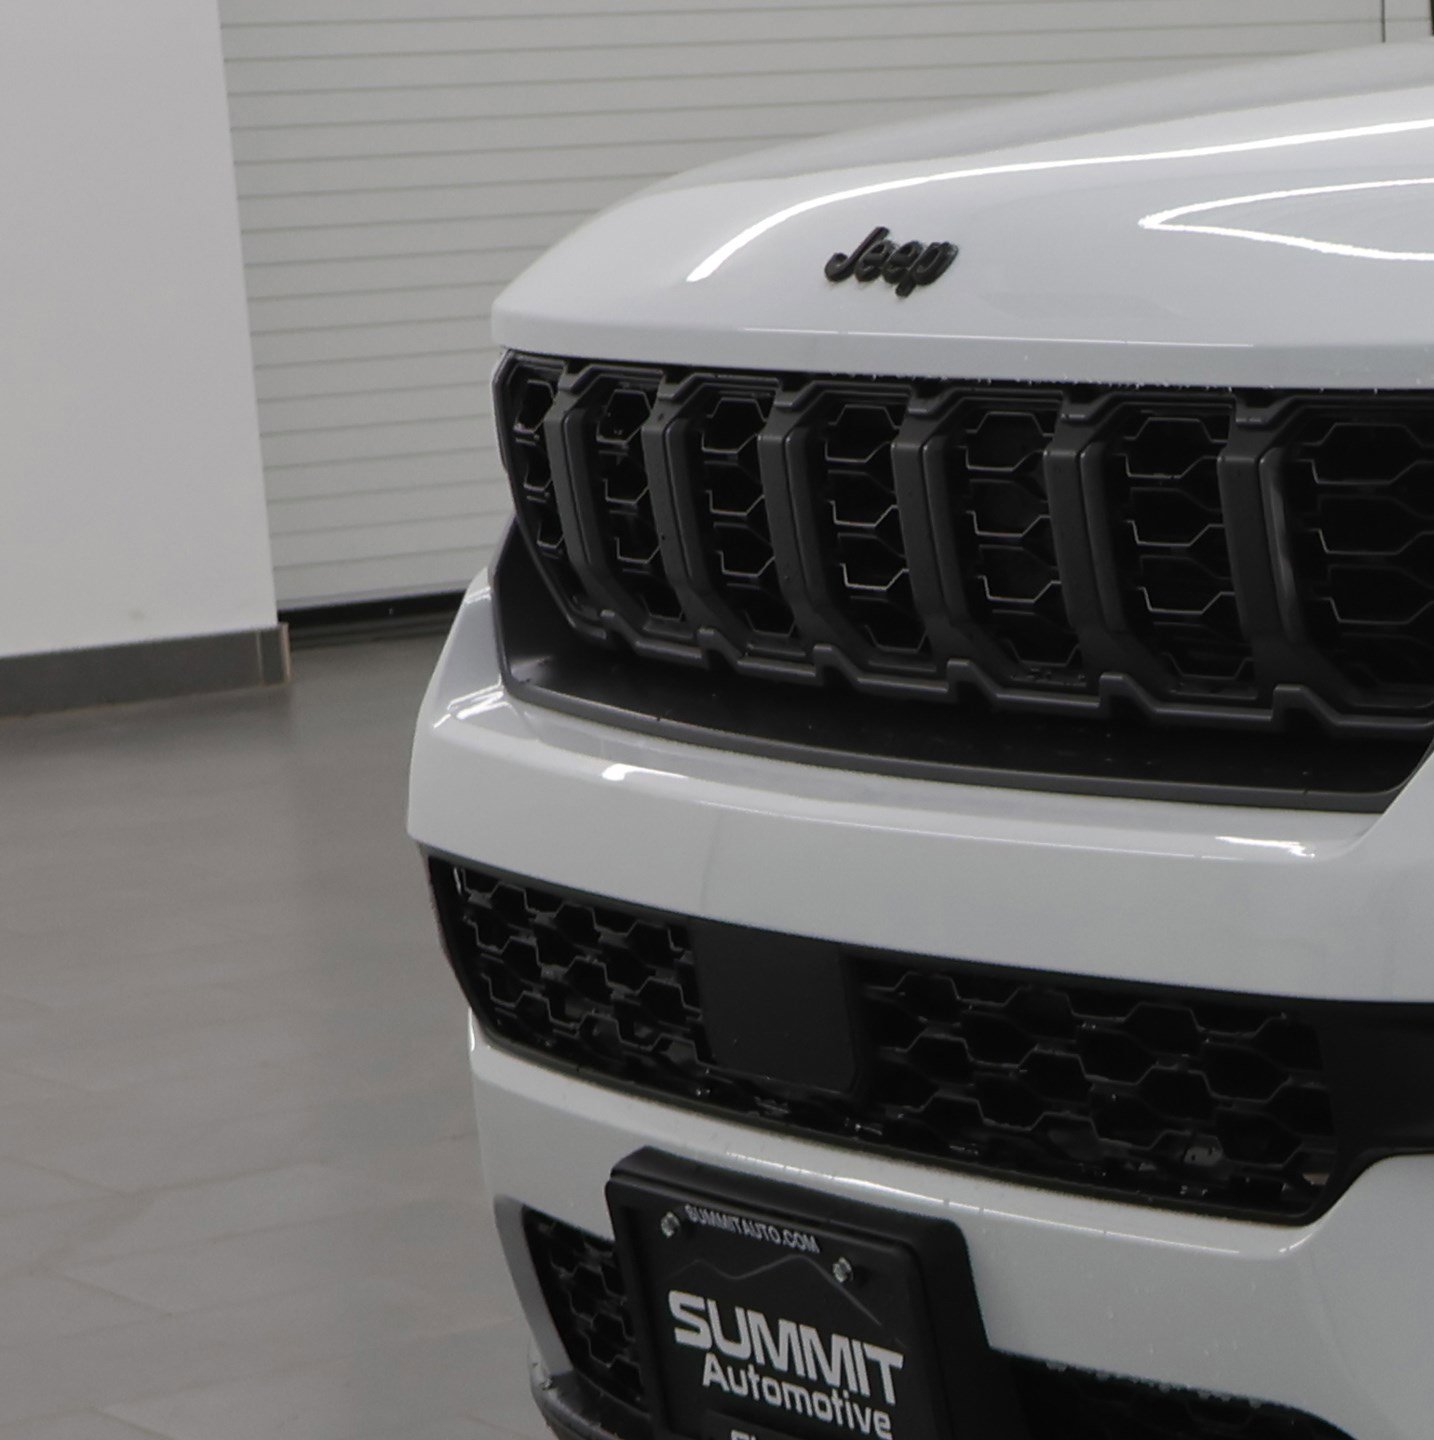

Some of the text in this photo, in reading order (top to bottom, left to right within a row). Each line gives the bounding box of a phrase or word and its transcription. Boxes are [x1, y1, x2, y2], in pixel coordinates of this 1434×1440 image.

[824, 226, 959, 298] Jeep
[684, 1203, 821, 1254] SUMMITAUTO.COM
[668, 1290, 904, 1405] SUMMIT
